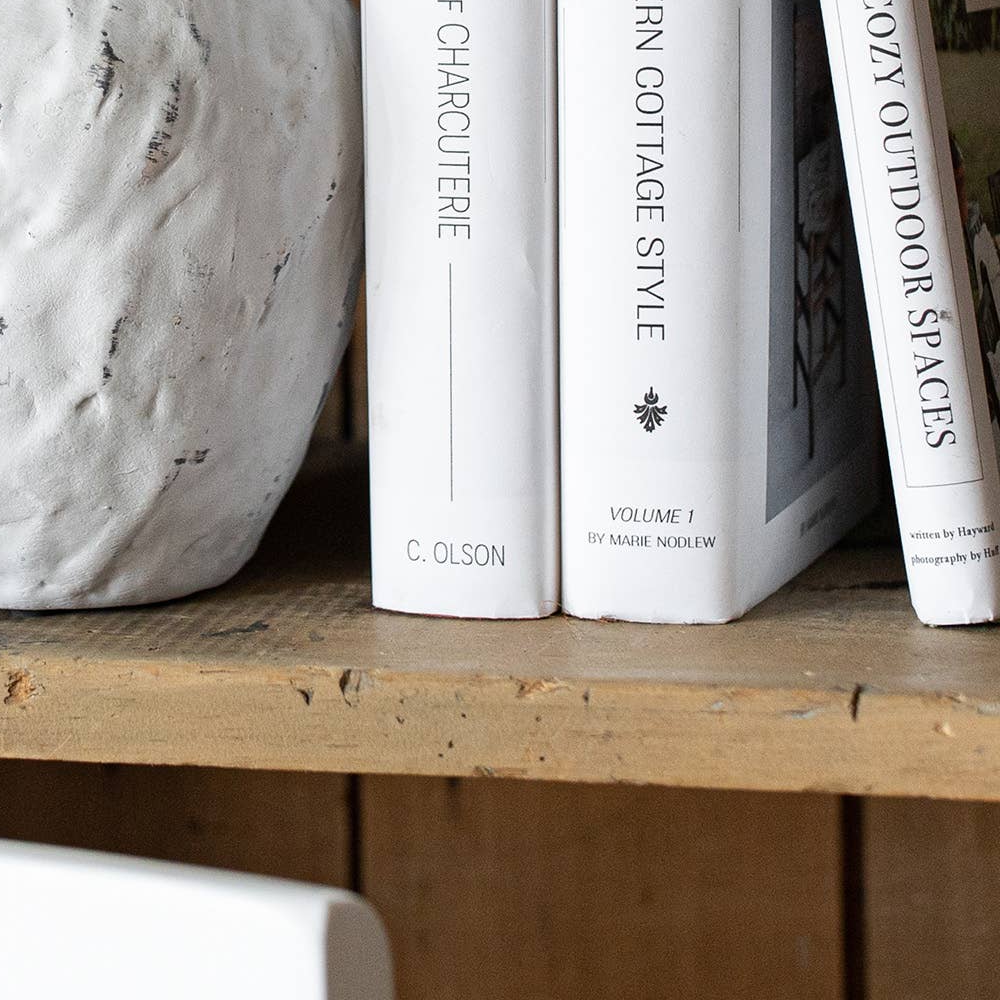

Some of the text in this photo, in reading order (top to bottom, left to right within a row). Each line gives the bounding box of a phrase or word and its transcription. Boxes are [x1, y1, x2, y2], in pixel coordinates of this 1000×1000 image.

[436, 23, 471, 240] CHARCUTERIE
[635, 66, 665, 223] COTTAGE
[636, 236, 666, 341] STYLE
[878, 101, 934, 299] OUTDOOR
[907, 308, 957, 449] SPACES
[609, 506, 695, 524] VOLUME 1
[588, 531, 717, 549] BY MARIE NODLEW
[909, 521, 995, 541] written by Hayward
[406, 538, 505, 568] C. OLSON
[911, 552, 967, 567] photography
[969, 551, 981, 563] by
